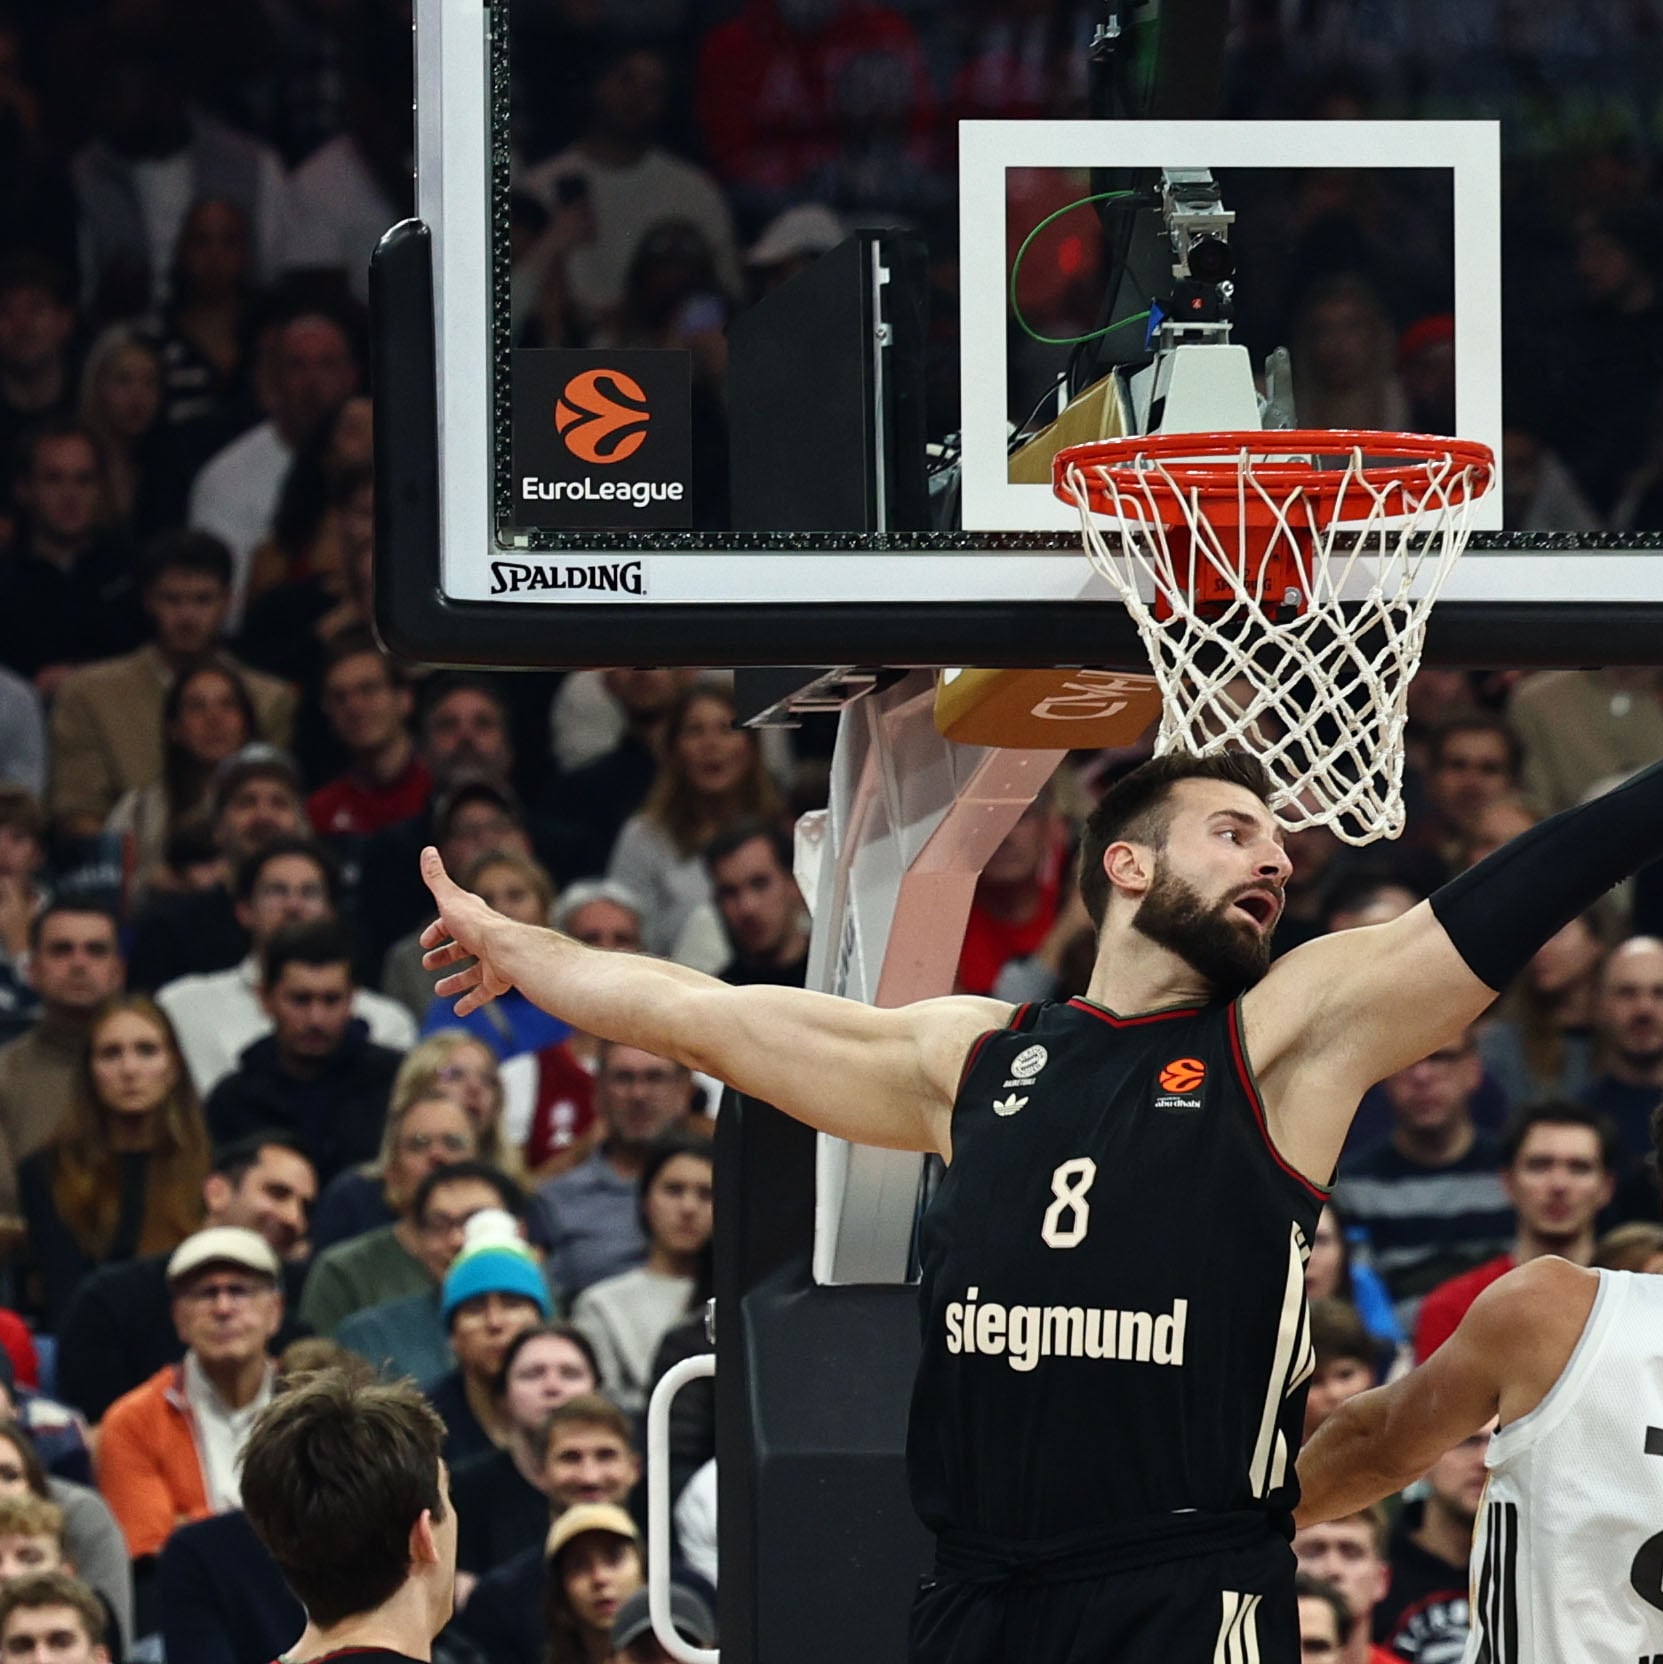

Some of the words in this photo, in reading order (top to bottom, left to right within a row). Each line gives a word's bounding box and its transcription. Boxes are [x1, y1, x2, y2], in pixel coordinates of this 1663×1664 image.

[522, 476, 685, 508] EuroLeague
[490, 560, 643, 595] SPALDING
[1041, 1157, 1097, 1249] 8
[945, 1286, 1188, 1372] siegmund
